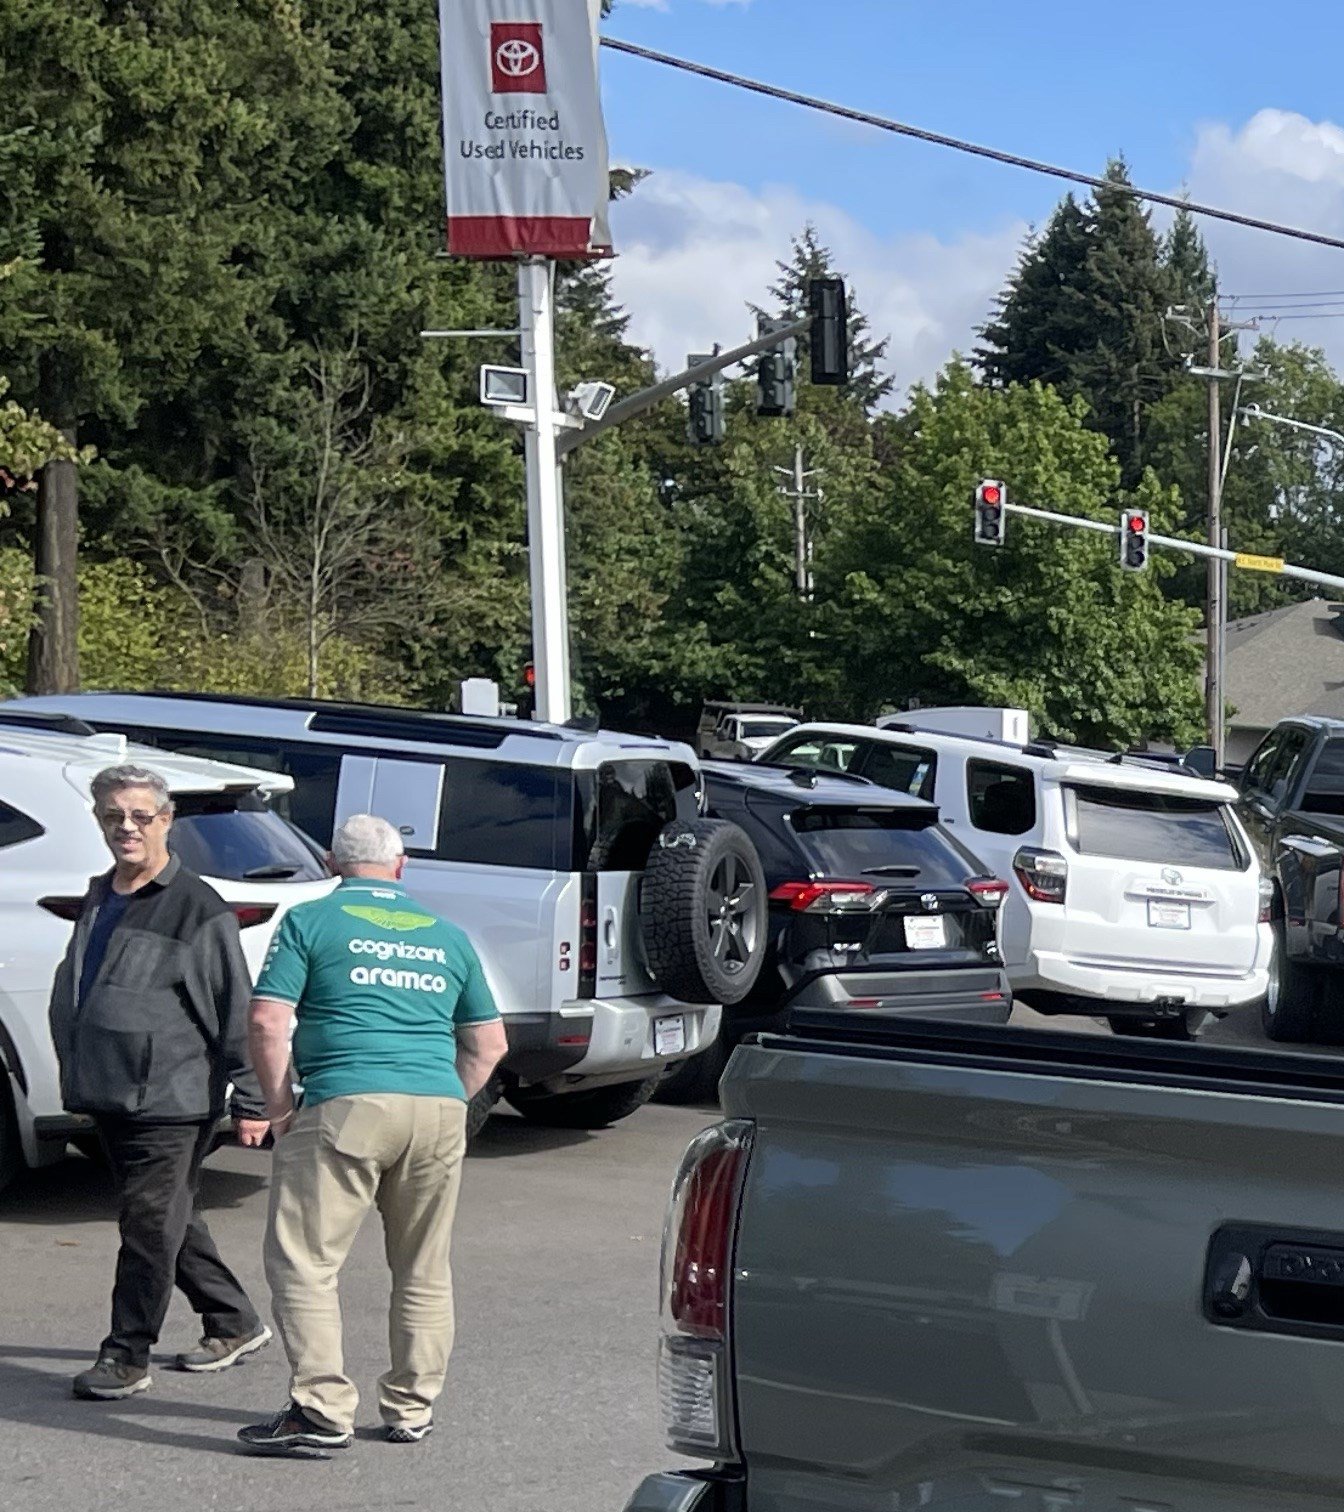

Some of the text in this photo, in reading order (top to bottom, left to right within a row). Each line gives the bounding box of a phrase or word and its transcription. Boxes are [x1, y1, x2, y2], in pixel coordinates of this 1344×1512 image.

[484, 109, 560, 132] Certified
[460, 140, 585, 161] Used Vehicles
[348, 938, 447, 965] cognizant
[350, 966, 447, 993] aramco
